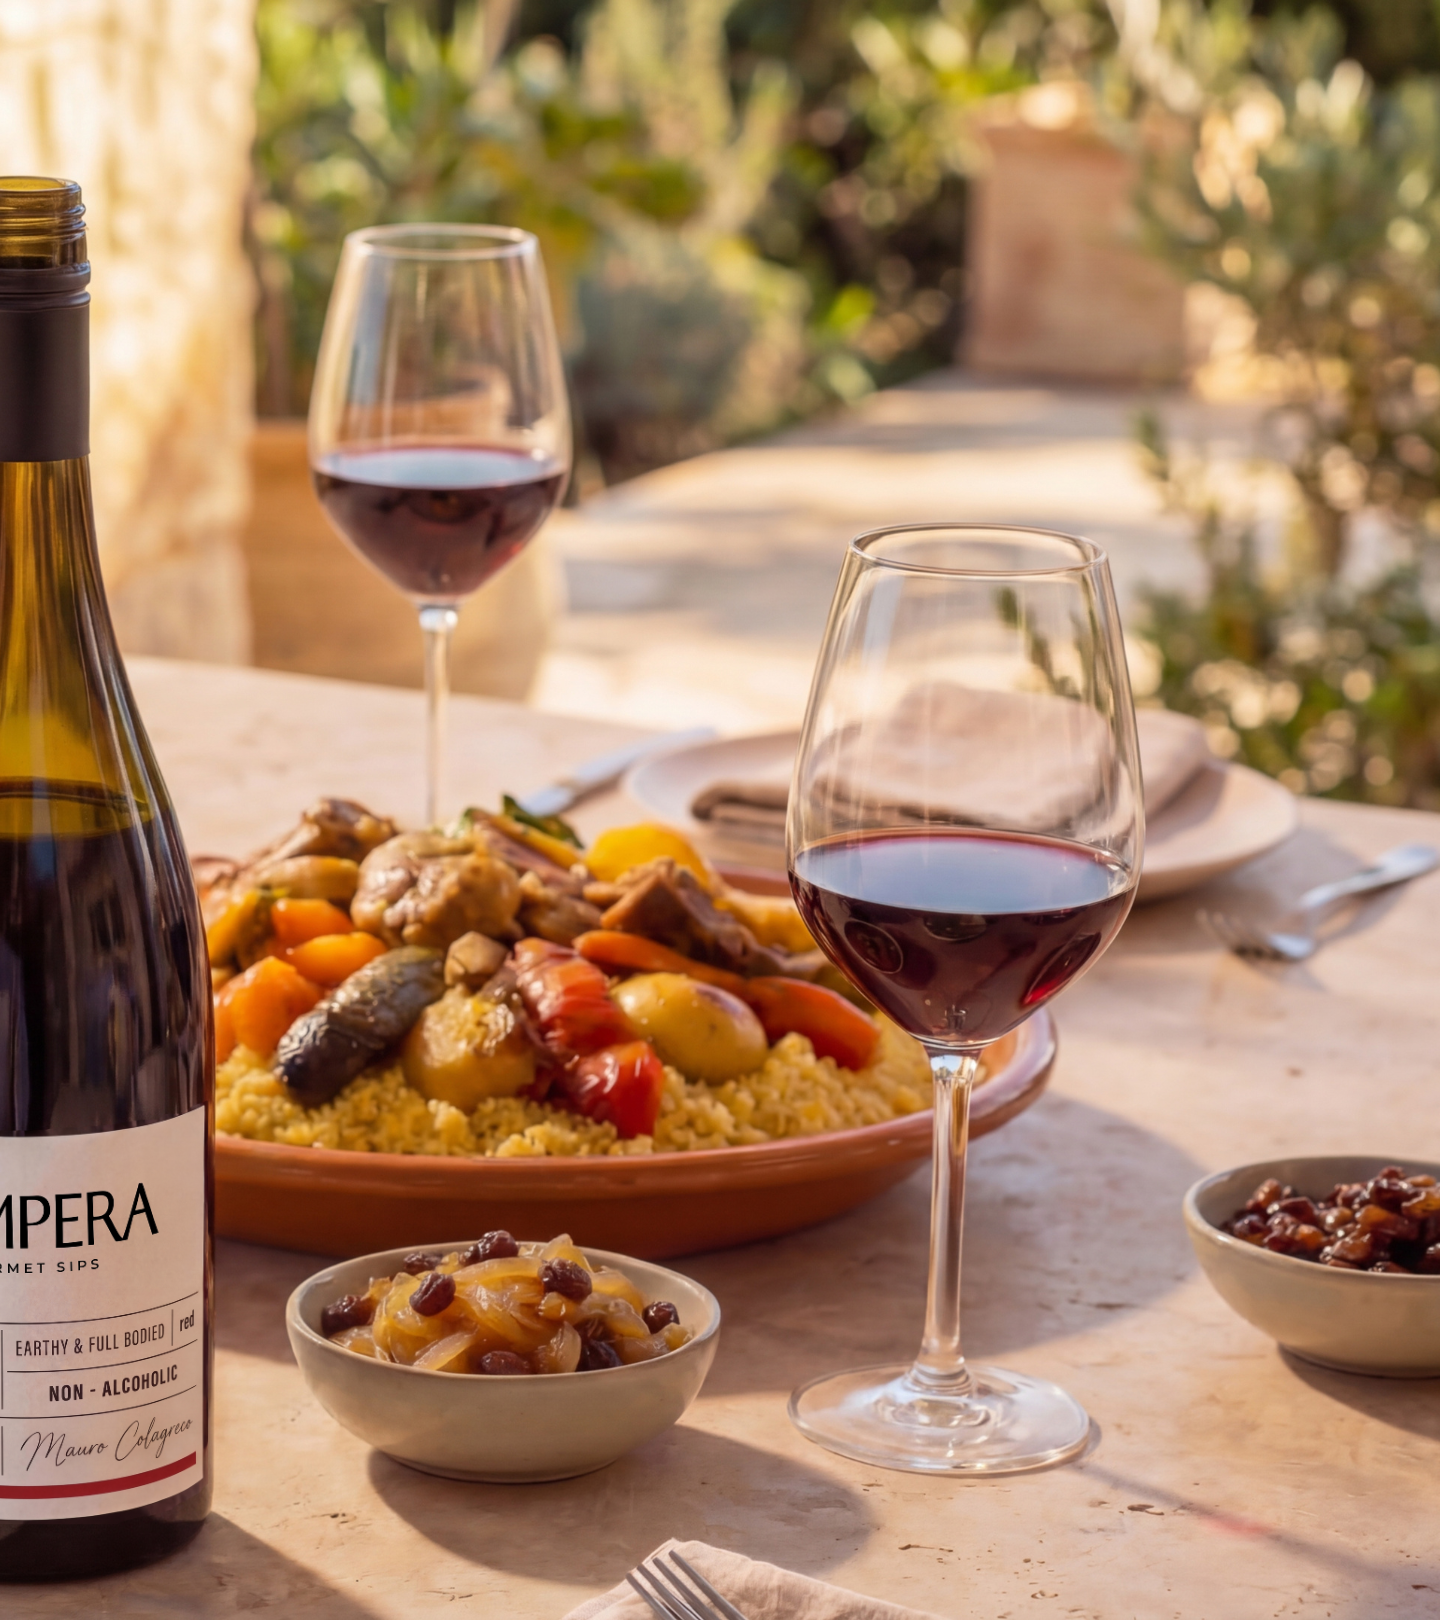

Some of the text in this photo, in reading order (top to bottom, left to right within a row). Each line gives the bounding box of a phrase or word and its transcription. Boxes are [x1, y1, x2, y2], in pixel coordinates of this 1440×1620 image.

[56, 1258, 100, 1273] SIPS
[179, 1309, 195, 1332] red
[15, 1323, 165, 1357] EARTHY & FULL BODIED
[49, 1383, 83, 1402] NON
[102, 1364, 178, 1397] ALCOHOLIC
[20, 1417, 194, 1472] Mauro Colagreco
